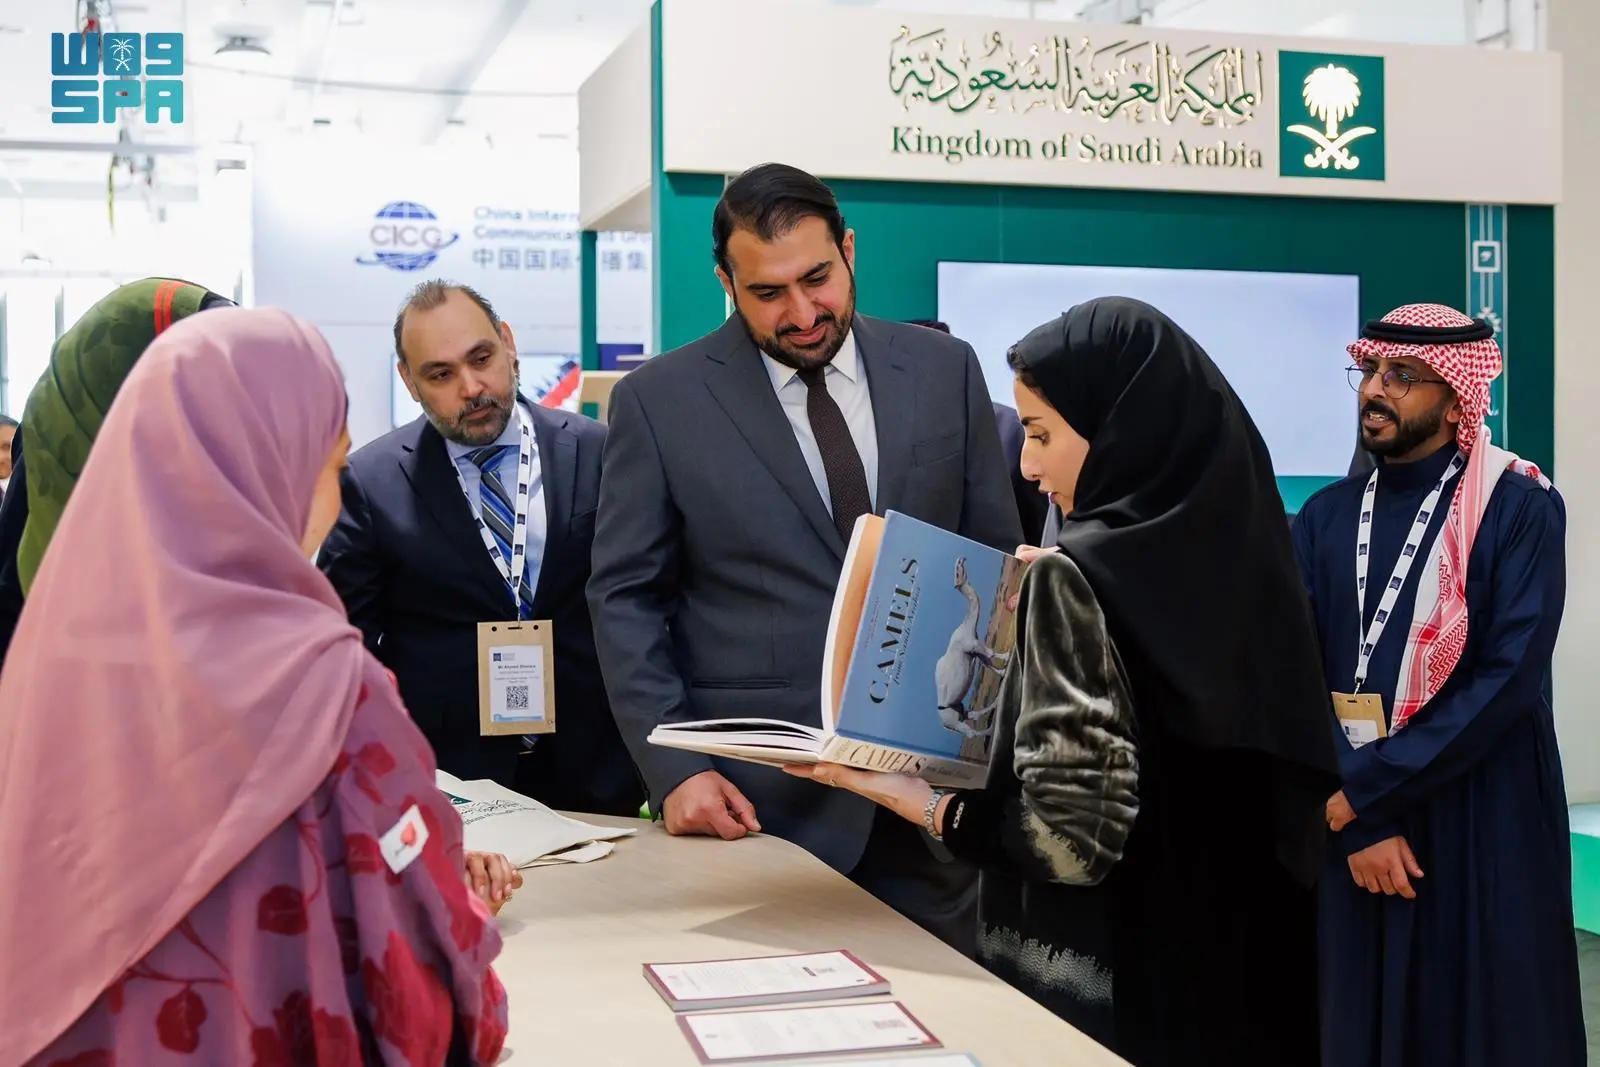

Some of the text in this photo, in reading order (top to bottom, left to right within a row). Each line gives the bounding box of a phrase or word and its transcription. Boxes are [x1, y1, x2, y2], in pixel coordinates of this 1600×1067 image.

[892, 126, 1263, 169] Kingdom of Saudi Arabia
[370, 224, 442, 249] CICG
[869, 557, 919, 704] CAMELS
[849, 743, 928, 776] CAMELS
